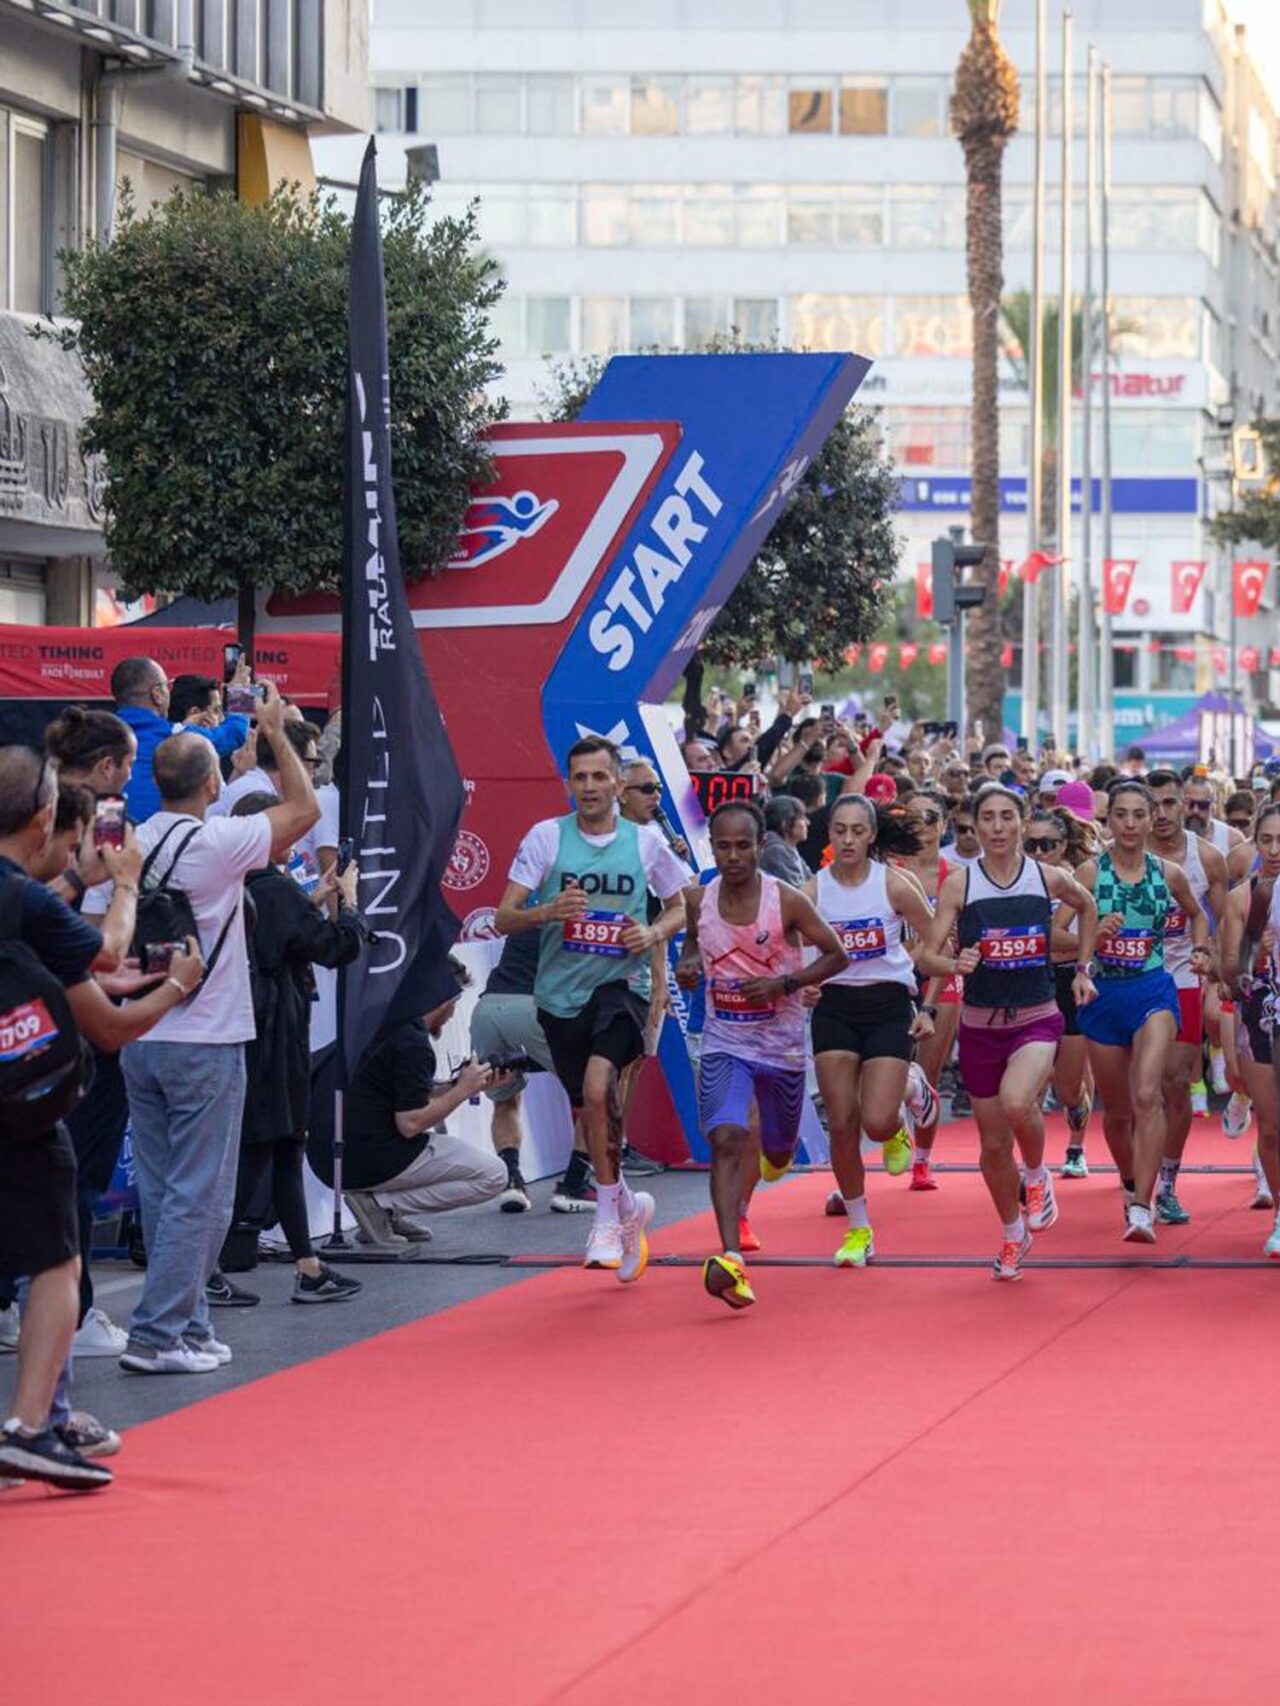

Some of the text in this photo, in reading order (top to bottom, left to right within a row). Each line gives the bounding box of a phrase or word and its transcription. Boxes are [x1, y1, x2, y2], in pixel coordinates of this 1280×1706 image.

[589, 450, 724, 672] START
[38, 645, 105, 660] TIMING
[256, 651, 289, 664] ING
[571, 922, 622, 943] 1897
[989, 938, 1038, 957] 2594
[1105, 939, 1146, 957] 1958
